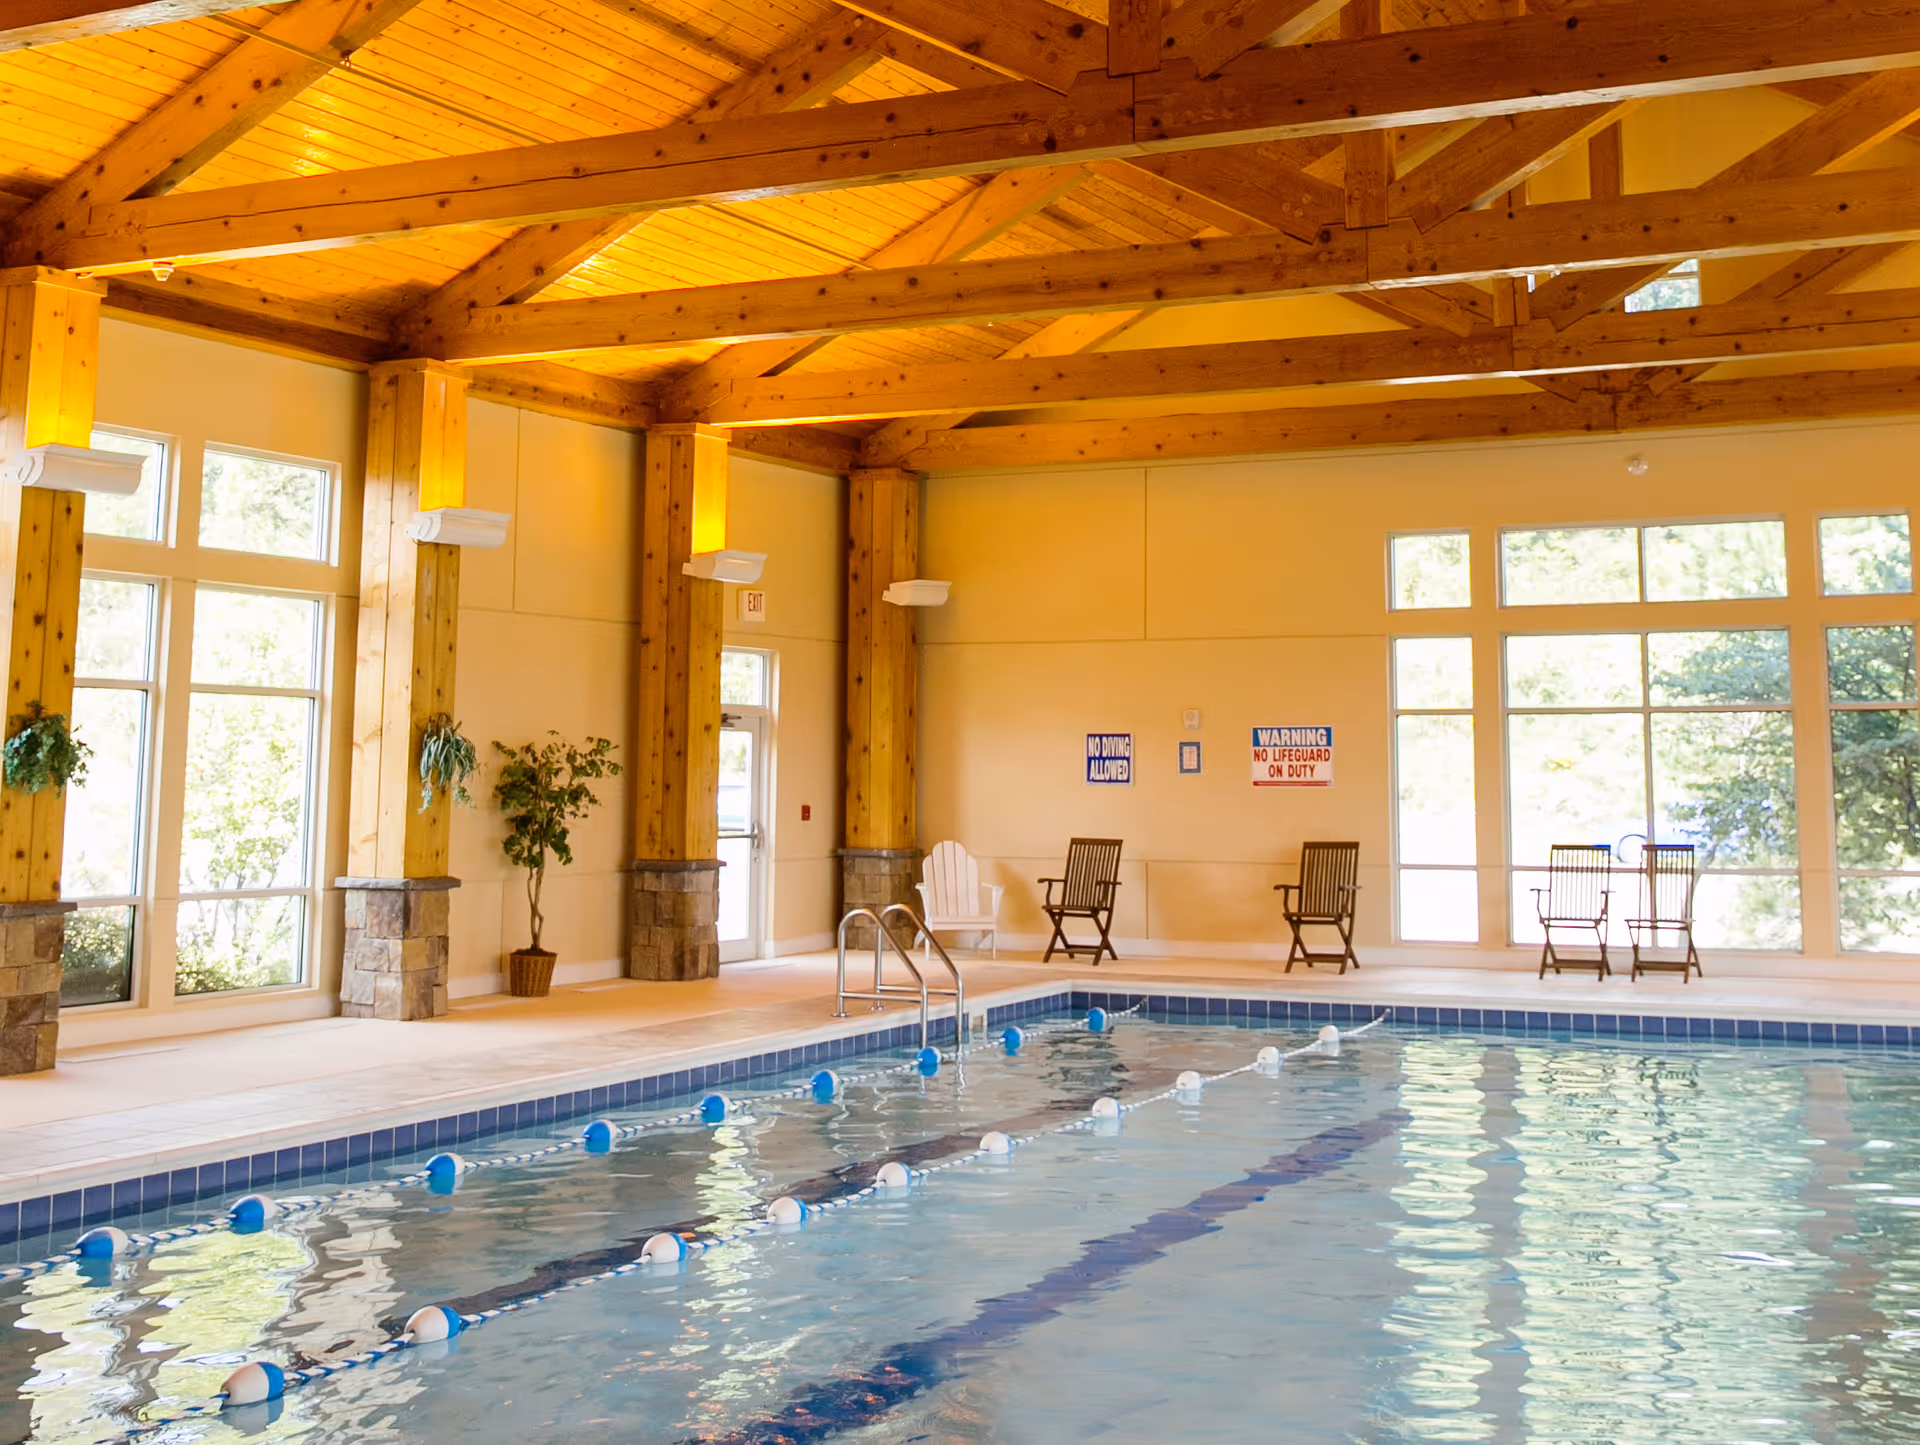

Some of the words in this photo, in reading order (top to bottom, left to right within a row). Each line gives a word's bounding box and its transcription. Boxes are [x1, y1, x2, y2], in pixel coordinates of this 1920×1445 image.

[748, 592, 763, 612] EXIT
[1088, 736, 1101, 757] NO
[1102, 736, 1130, 757] DIVING
[1257, 728, 1328, 746] WARNING
[1253, 748, 1268, 762] NO
[1273, 748, 1331, 762] LIFEGUARD
[1090, 759, 1129, 780] ALLOWED
[1268, 764, 1283, 778] ON
[1288, 764, 1316, 778] DUTY
